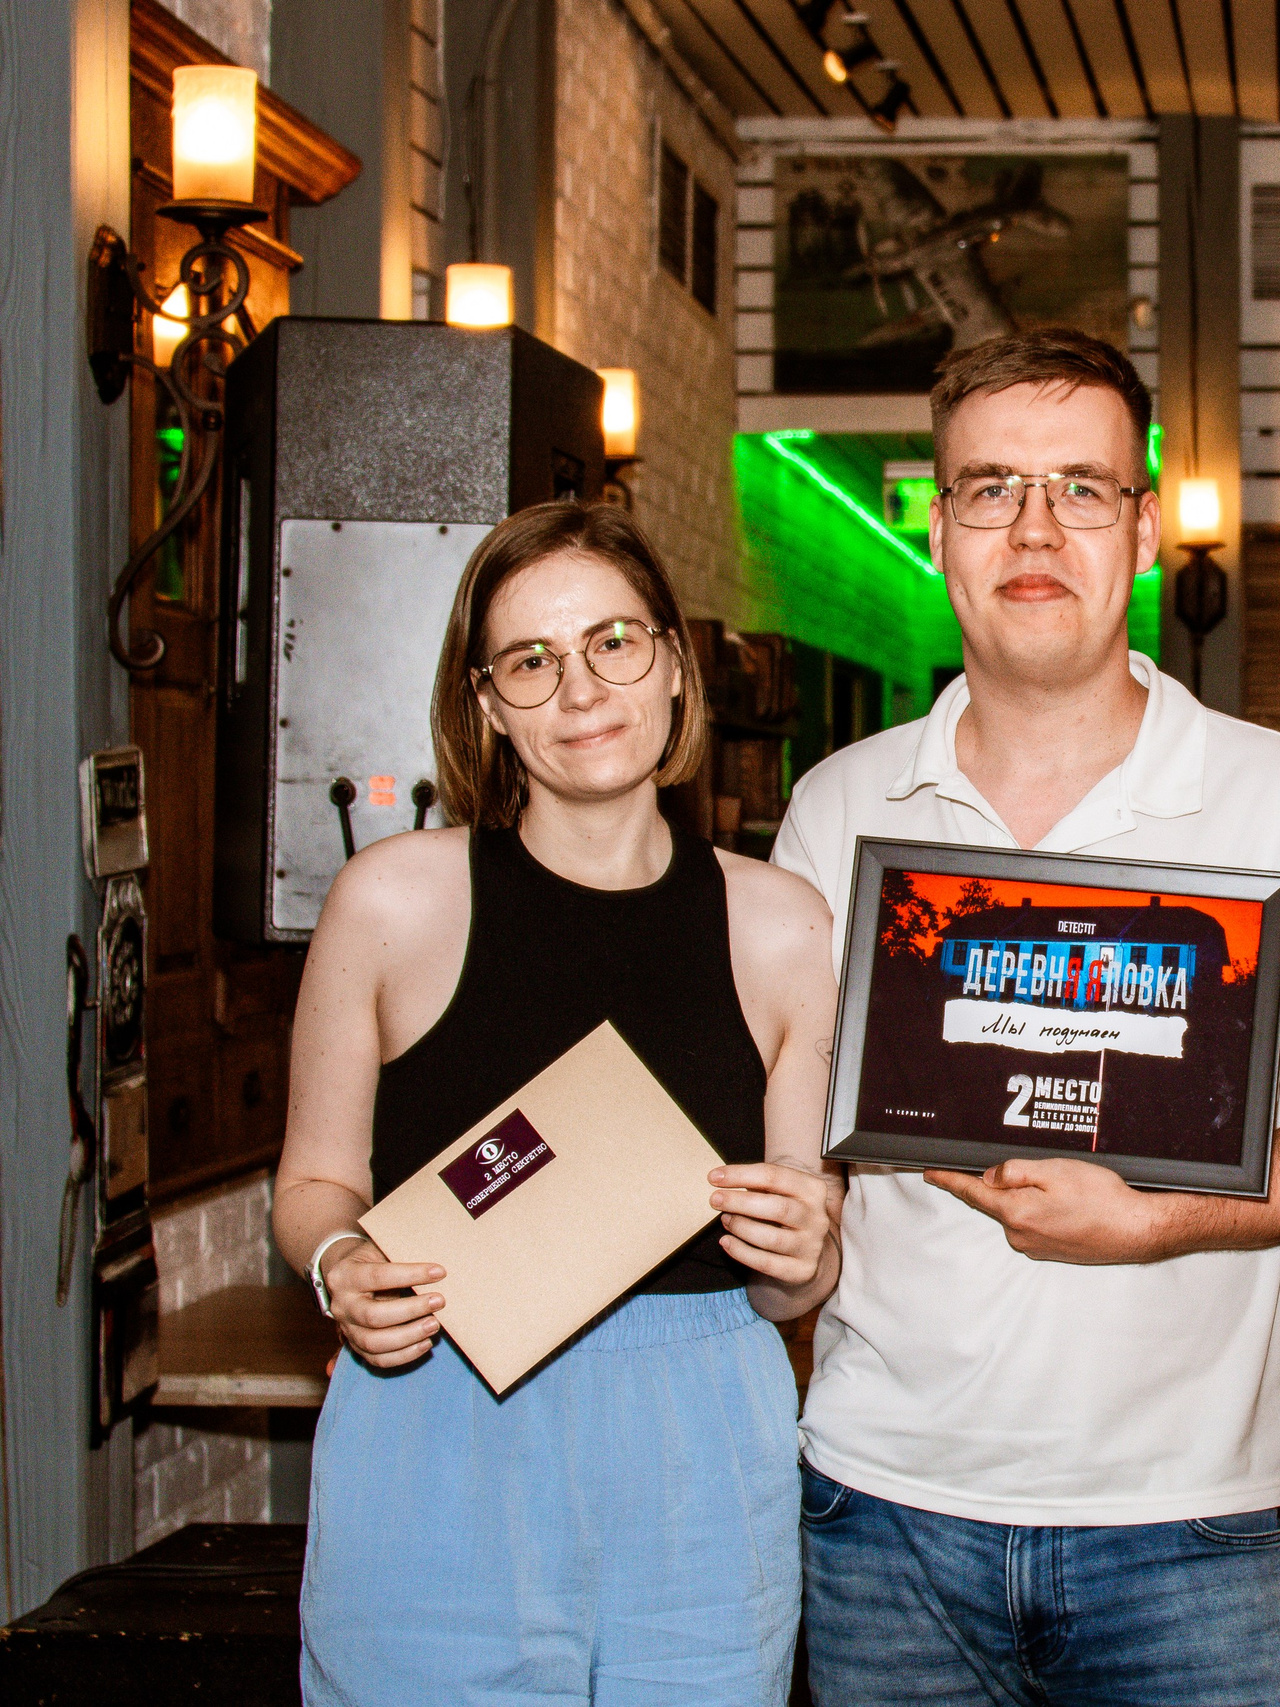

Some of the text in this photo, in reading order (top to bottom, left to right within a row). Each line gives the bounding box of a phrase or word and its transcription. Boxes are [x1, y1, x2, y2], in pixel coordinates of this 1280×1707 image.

[1057, 920, 1096, 935] DETECTIT
[963, 947, 1081, 1000] ДЕРЕВНЯ
[981, 1013, 1027, 1036] Мы
[1003, 1074, 1102, 1127] 2 МЕСТО
[1032, 1120, 1098, 1133] ОДИН ШАГ ДО ЗОЛОТА
[466, 1142, 548, 1210] СОВЕРШЕННО СЕКРЕТНО
[484, 1151, 519, 1181] 2 МЕСТО
